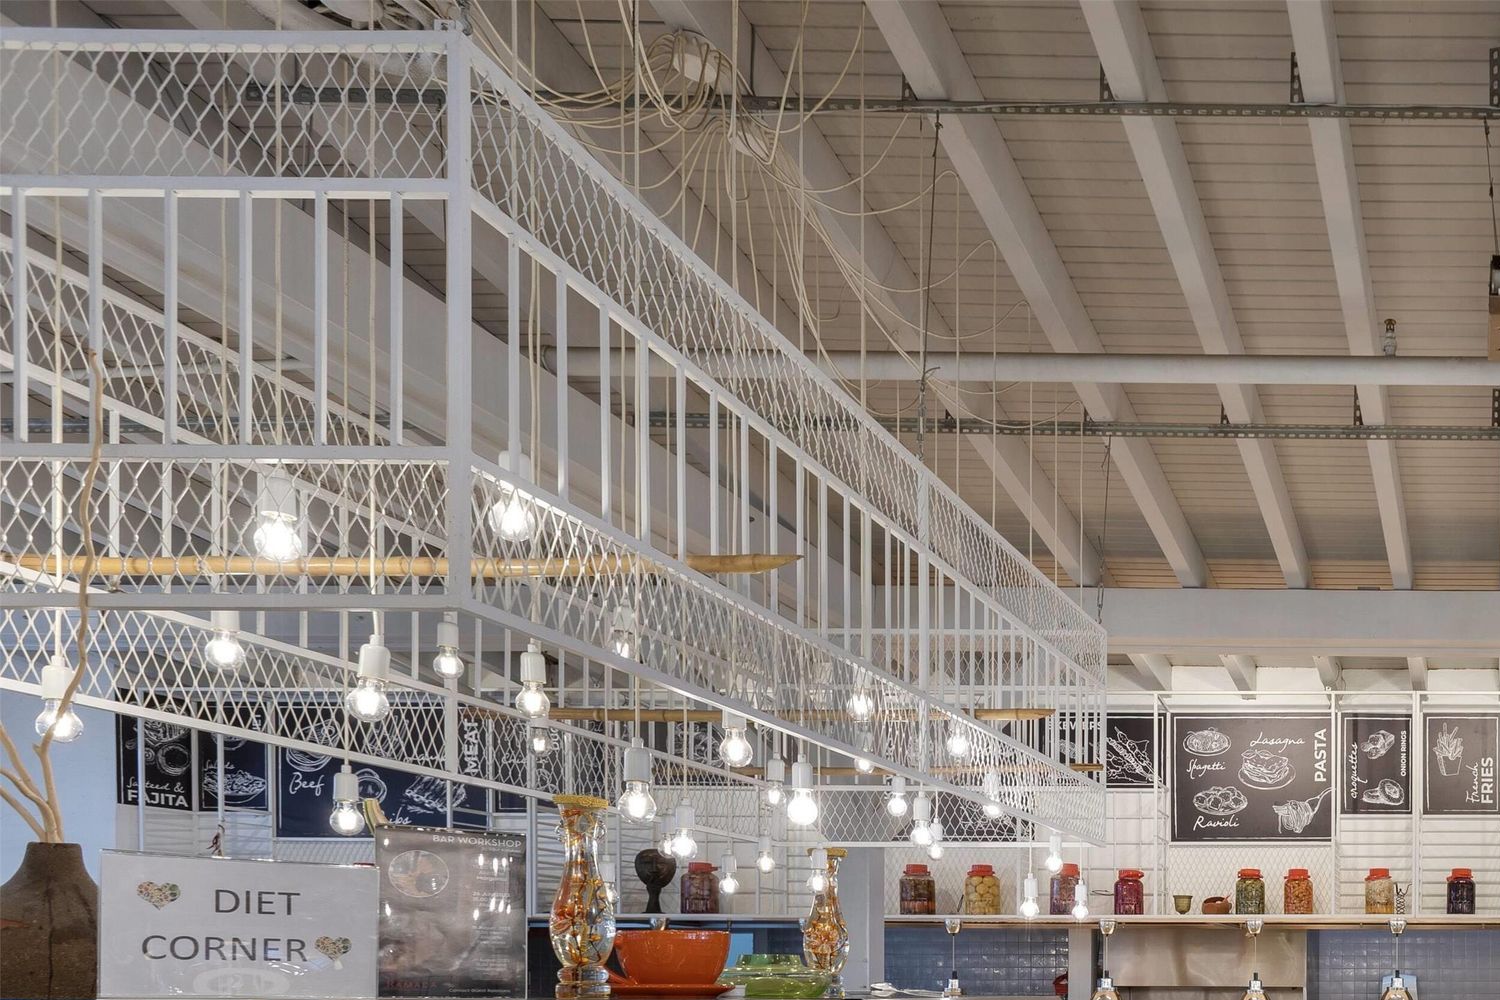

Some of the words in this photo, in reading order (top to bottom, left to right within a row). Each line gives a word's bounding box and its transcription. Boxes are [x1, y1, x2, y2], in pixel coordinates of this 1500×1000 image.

[464, 718, 479, 773] MEAT
[1250, 732, 1306, 753] Lasagna
[1314, 728, 1327, 782] PASTA
[1186, 758, 1226, 780] Spagetti
[1349, 742, 1368, 799] croquettes
[1466, 761, 1480, 803] French
[1481, 757, 1494, 804] FRIES
[126, 776, 171, 790] Sateed
[173, 782, 185, 793] &
[289, 772, 326, 796] Beef
[389, 806, 412, 824] ibs
[1193, 814, 1240, 831] Ravioli
[432, 834, 455, 843] BAR
[457, 835, 522, 848] WORKSHOP
[214, 888, 301, 917] DIET
[141, 934, 308, 963] CORNER
